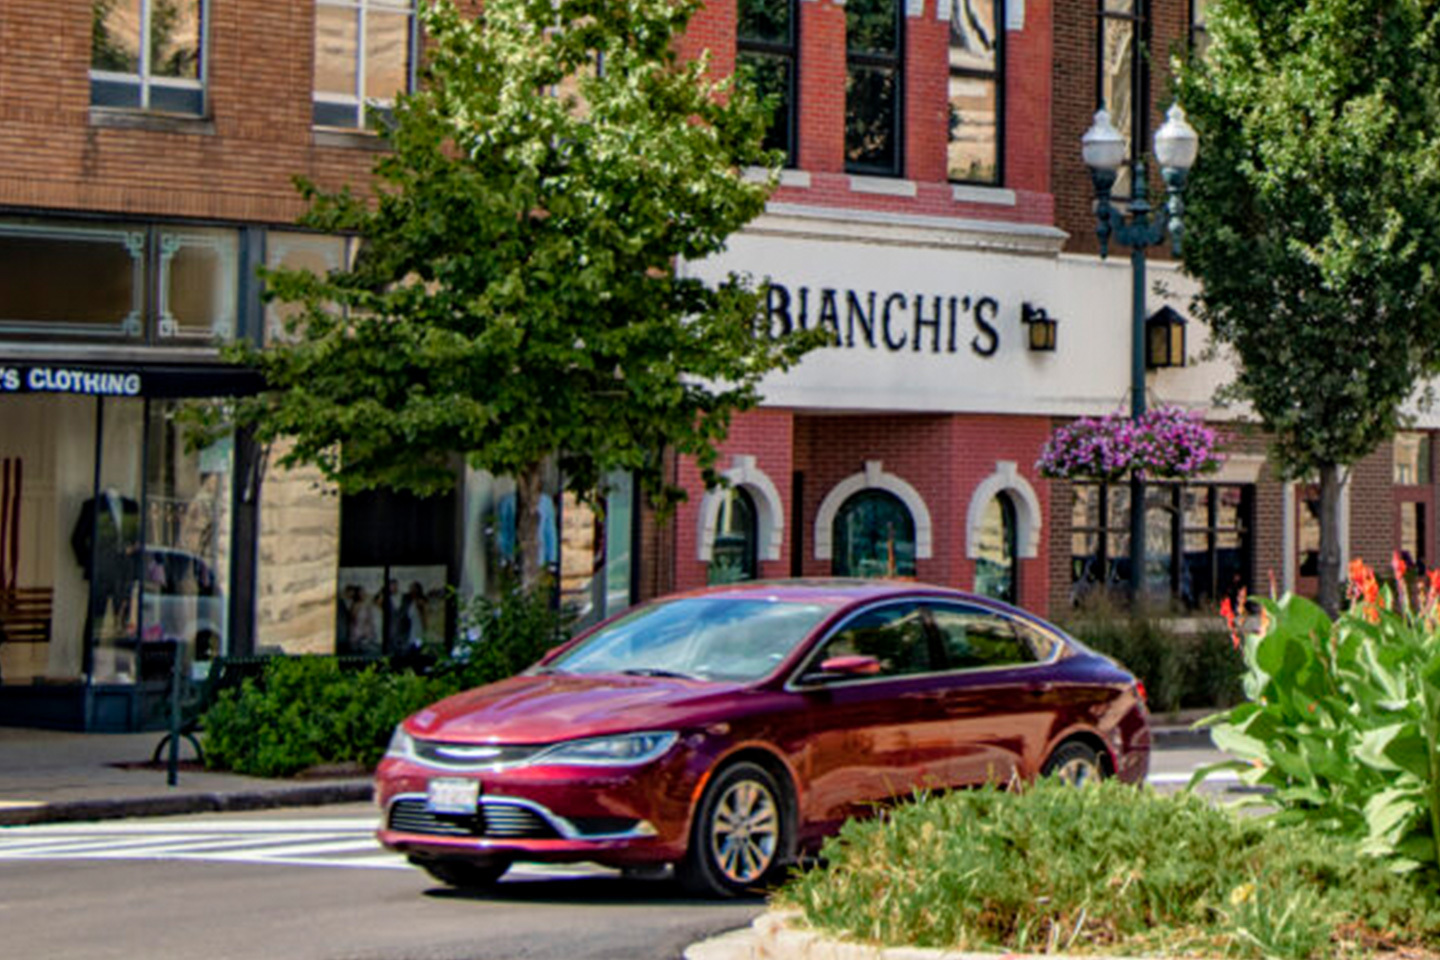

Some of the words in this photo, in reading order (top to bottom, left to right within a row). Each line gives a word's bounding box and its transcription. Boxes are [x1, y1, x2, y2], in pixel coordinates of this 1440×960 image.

[766, 282, 1000, 358] BIANCHI'S
[0, 366, 20, 391] 'S
[27, 367, 141, 395] CLOTHING
